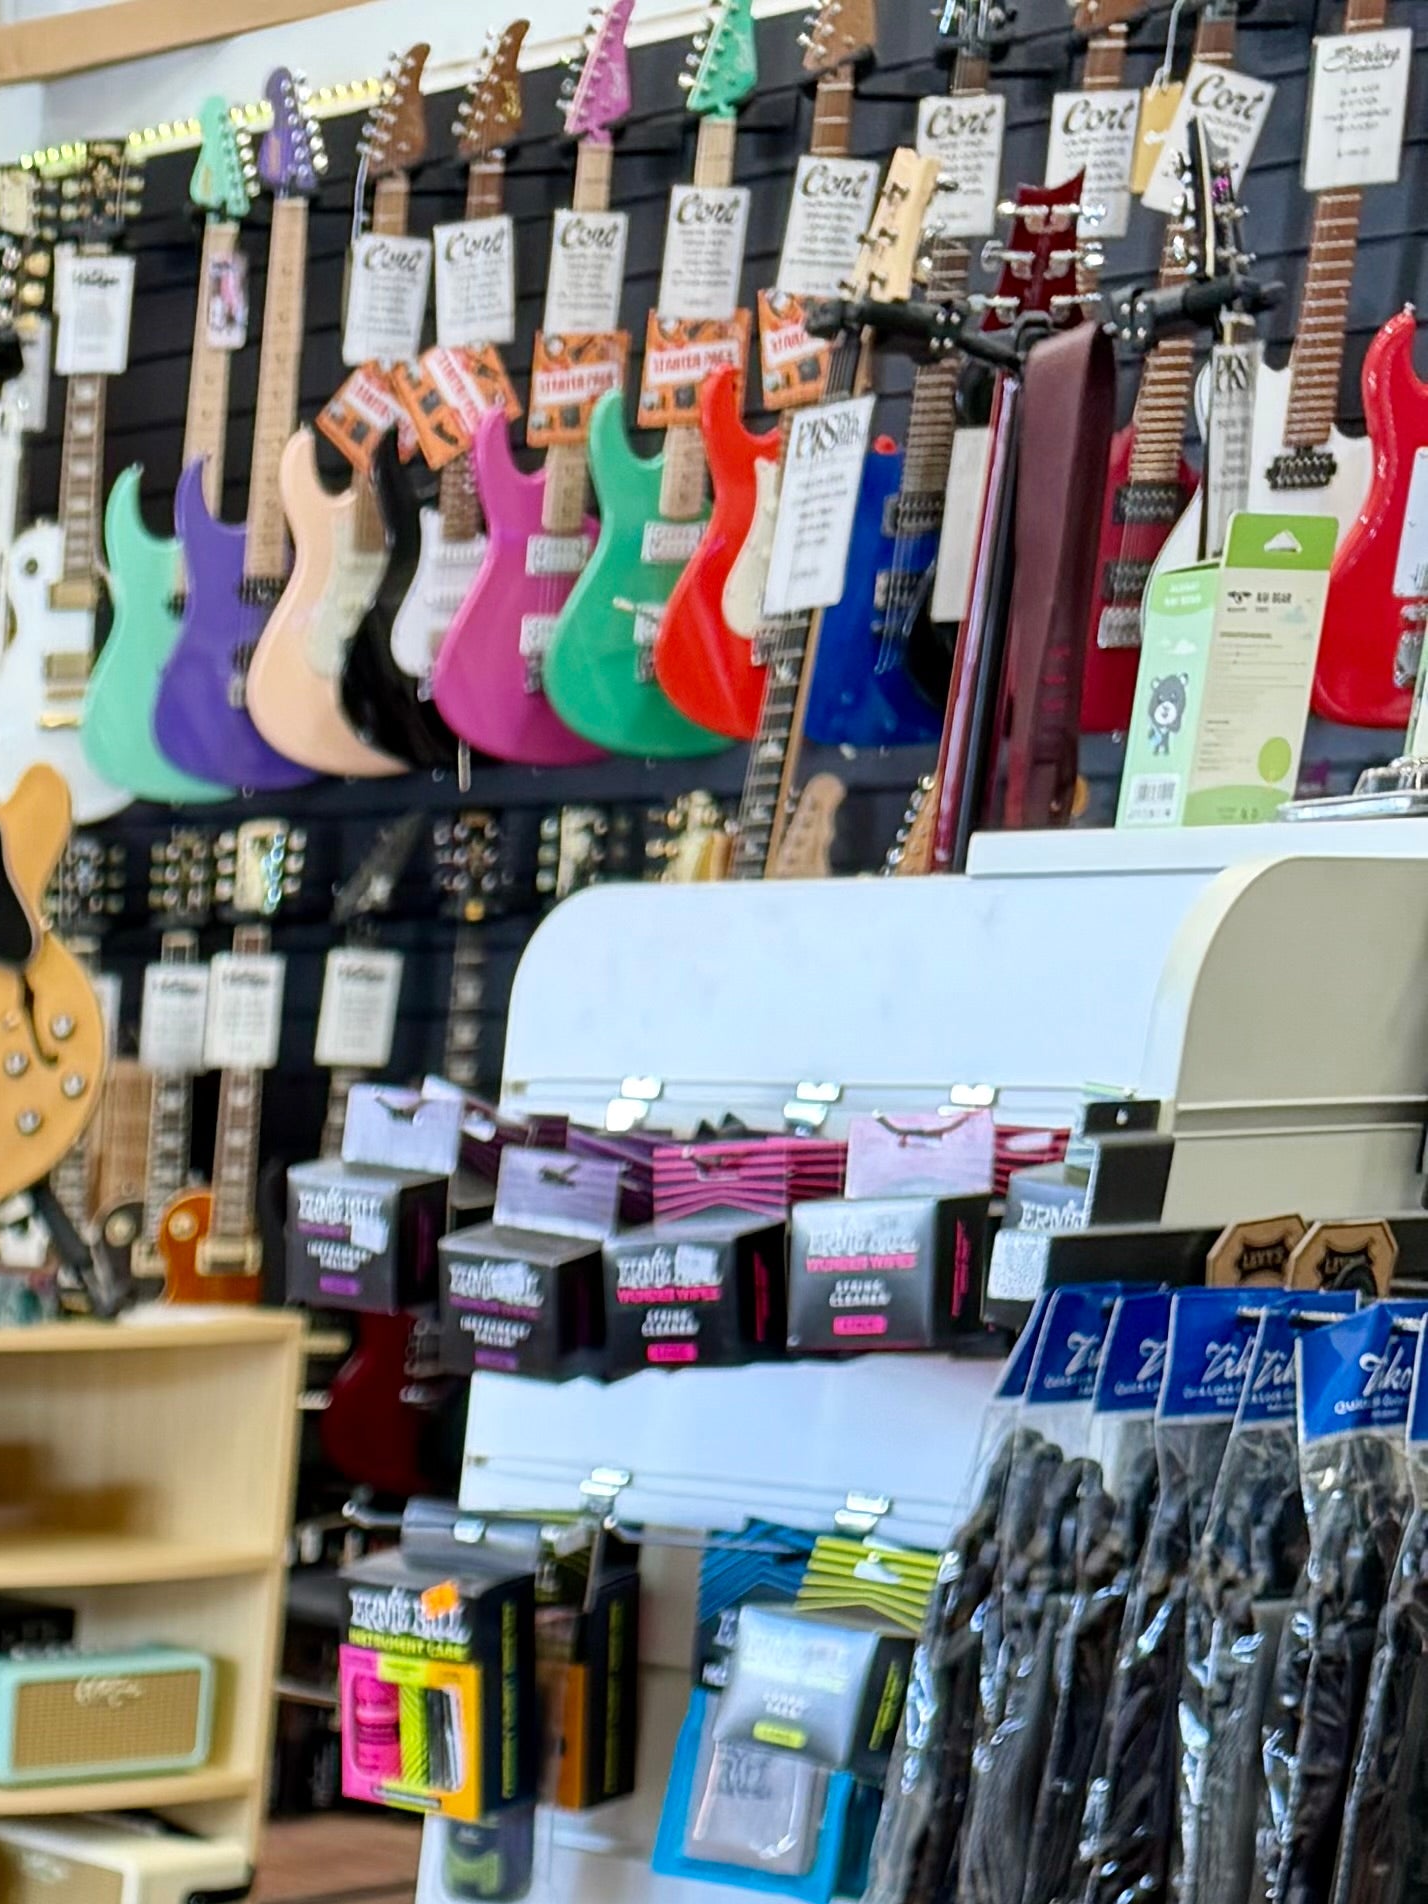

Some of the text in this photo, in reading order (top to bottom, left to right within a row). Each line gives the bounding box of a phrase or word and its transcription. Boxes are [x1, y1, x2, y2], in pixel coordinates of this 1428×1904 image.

[1192, 73, 1264, 120] Cort
[927, 105, 996, 140] Cort
[1062, 98, 1137, 135] Cort
[800, 164, 870, 198] Cort
[676, 191, 742, 226] Cort
